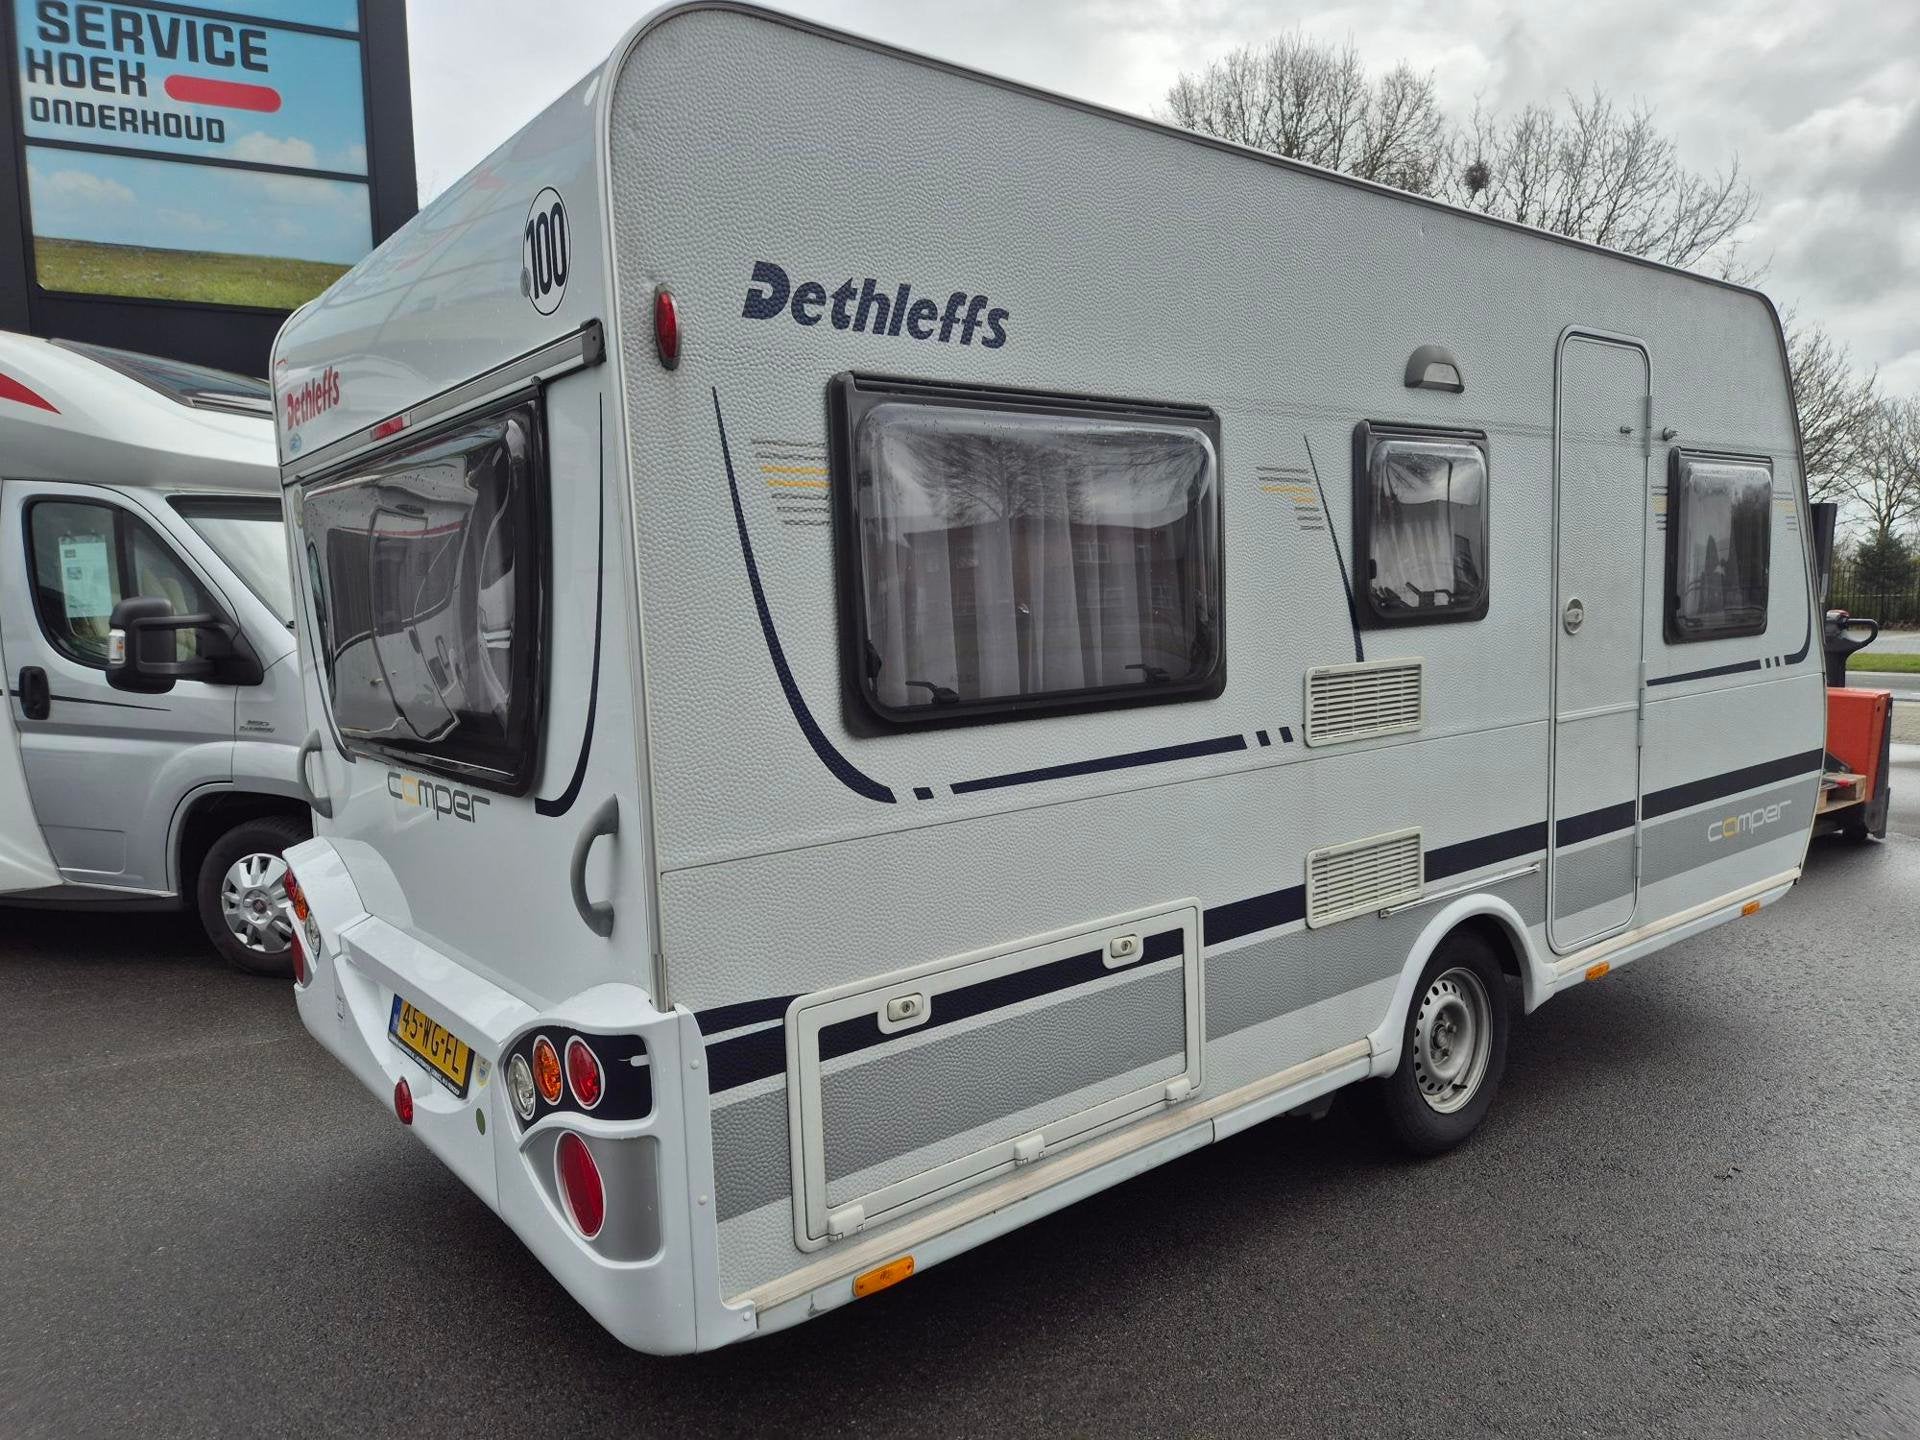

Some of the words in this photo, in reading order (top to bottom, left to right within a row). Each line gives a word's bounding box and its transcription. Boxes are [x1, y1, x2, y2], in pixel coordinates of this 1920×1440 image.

[25, 46, 148, 98] HOEK
[36, 0, 270, 73] SERVICE
[29, 96, 226, 144] ONDERHOUD
[525, 201, 568, 300] 100
[741, 260, 1010, 350] Dethleffs
[286, 365, 341, 432] Dethleffs
[402, 1003, 460, 1075] 45-WG-FL
